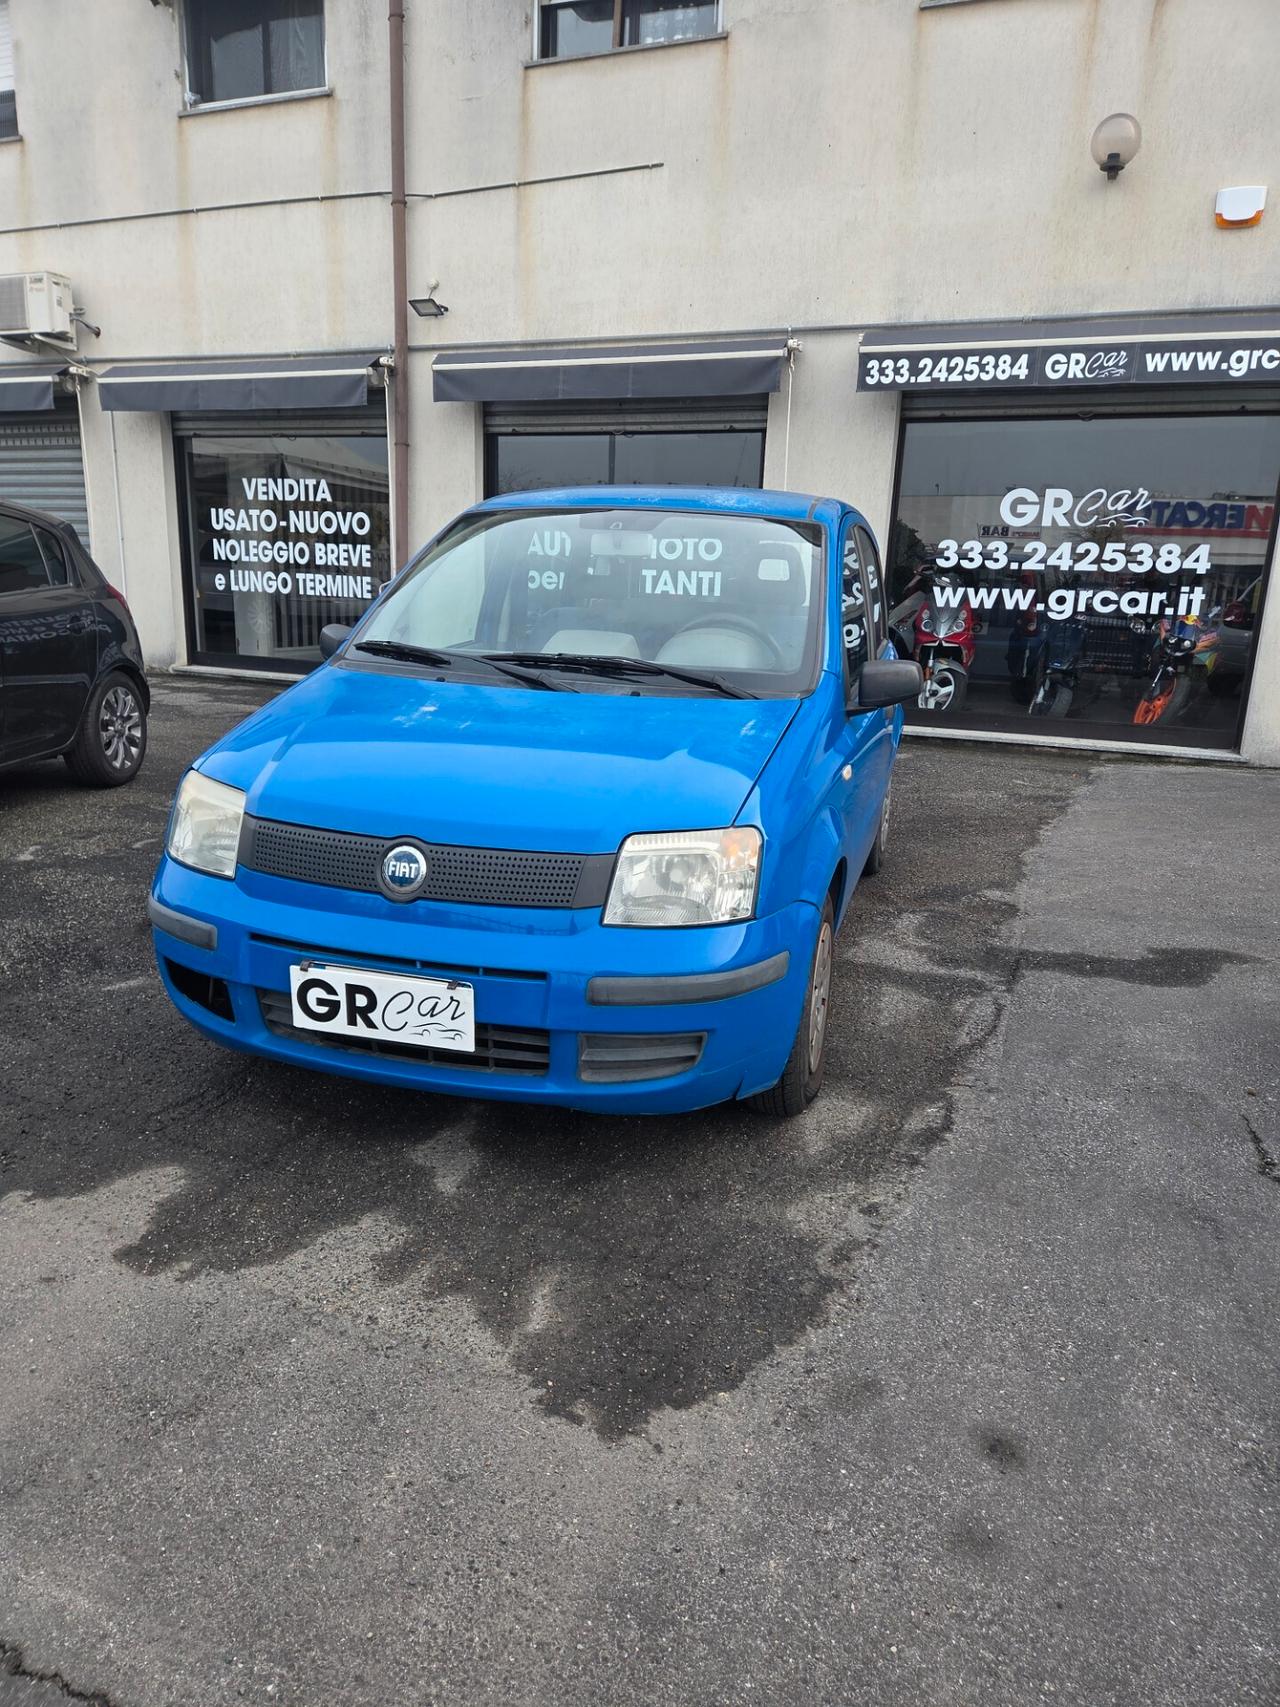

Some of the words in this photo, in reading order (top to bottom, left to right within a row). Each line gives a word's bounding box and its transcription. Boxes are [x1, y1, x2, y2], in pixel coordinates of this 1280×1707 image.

[865, 353, 1029, 385] 333.2425384
[1145, 348, 1280, 378] www.grc
[242, 478, 333, 502] VENDITA
[212, 538, 309, 565] NOLEGGIO
[315, 542, 371, 568] BREVE
[936, 539, 1211, 574] 333.2425384
[214, 573, 226, 590] e
[229, 570, 292, 595] LUNGO
[296, 573, 372, 599] TERMINE
[932, 585, 1206, 620] www.grcar.it
[388, 861, 419, 879] FIAT
